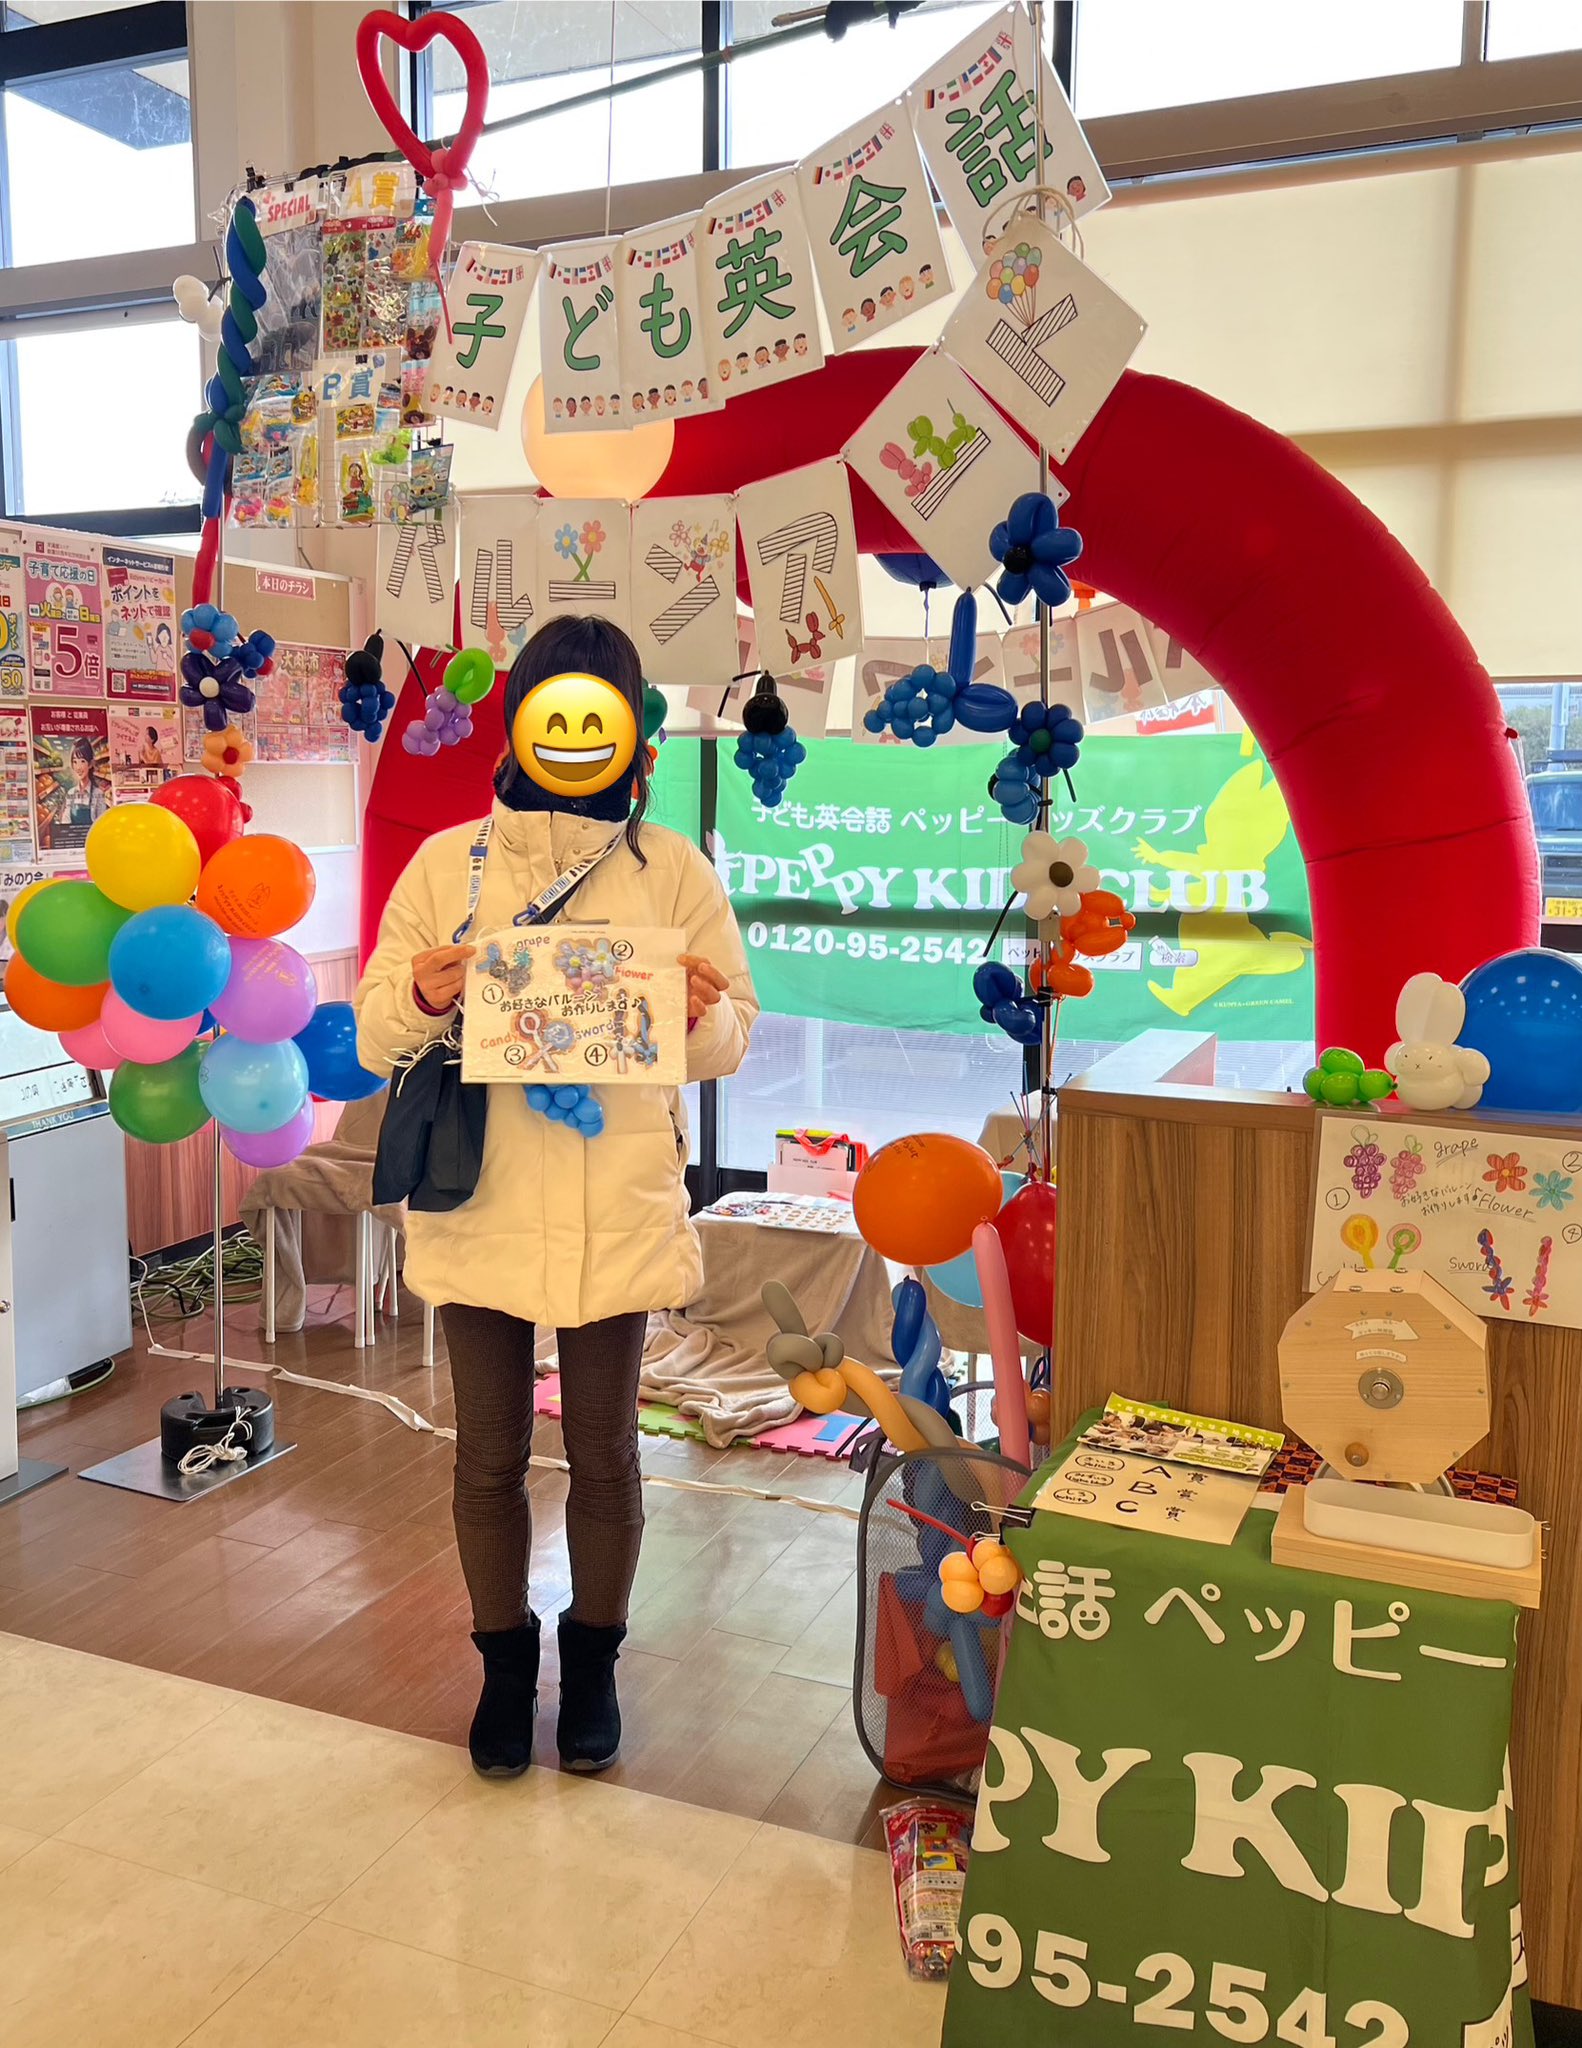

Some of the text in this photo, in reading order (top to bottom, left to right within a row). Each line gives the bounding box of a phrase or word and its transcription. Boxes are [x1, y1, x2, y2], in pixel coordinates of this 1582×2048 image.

[268, 194, 311, 223] SPECIAL
[452, 69, 1053, 372] 子ども英会話
[28, 560, 96, 583] 子育て応援の日
[111, 584, 160, 602] ポイントを
[262, 576, 310, 595] 本日のチラシ
[121, 604, 171, 622] ネットで確認
[8, 612, 18, 651] ポイント
[1, 669, 23, 689] 50
[751, 803, 1203, 835] 子ども英会話 ペッピーッズクラブ
[739, 842, 903, 915] PEPPY
[516, 935, 550, 951] grape
[747, 921, 988, 965] 0120-95-2542
[500, 991, 598, 1013] お好きなバルーン
[32, 1111, 75, 1129] THANK YOU
[1433, 1137, 1479, 1158] grape
[1479, 1193, 1535, 1220] Flower
[1142, 1465, 1173, 1479] A
[1128, 1481, 1158, 1495] B
[1115, 1500, 1139, 1513] C
[1143, 1582, 1508, 1682] ペッピー
